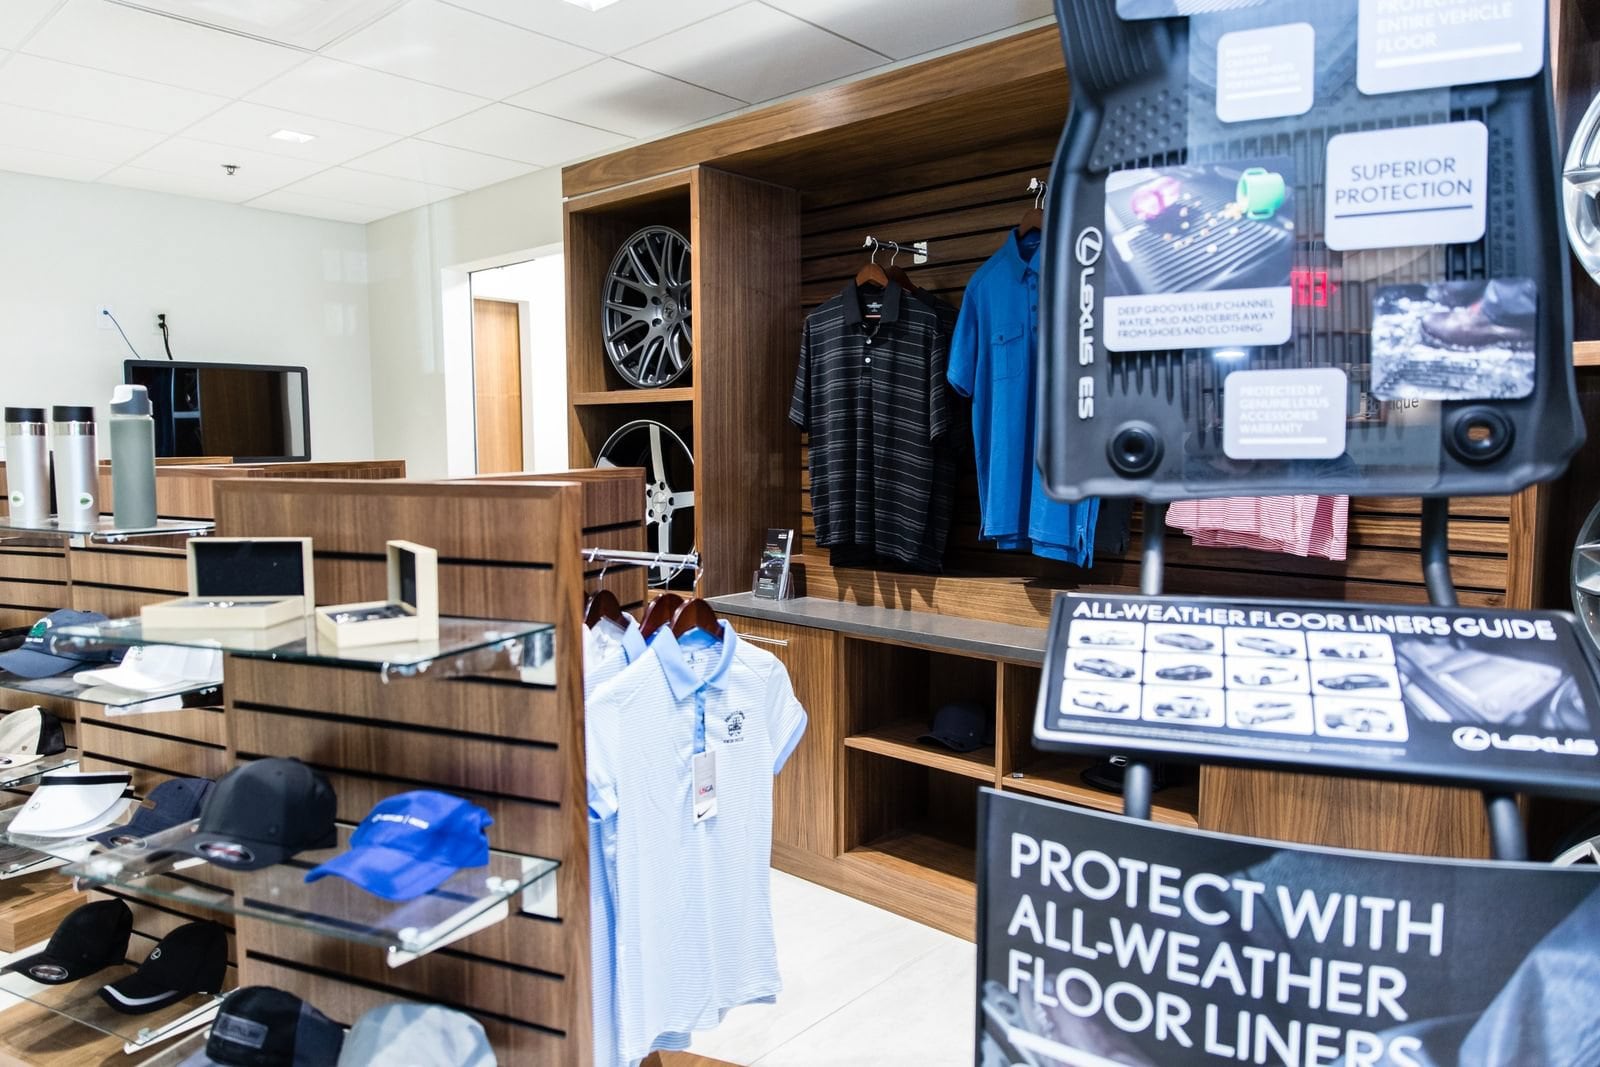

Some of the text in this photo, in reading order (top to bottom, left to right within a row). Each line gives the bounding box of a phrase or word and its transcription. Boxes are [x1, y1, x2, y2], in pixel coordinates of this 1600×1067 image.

[1376, 0, 1467, 15] PROTEC
[1376, 1, 1513, 34] ENTIRE VEHICLE
[1375, 31, 1440, 54] FLOOR
[1351, 157, 1457, 182] SUPERIOR
[1335, 178, 1473, 205] PROTECTION
[1079, 267, 1095, 366] LEXUS
[1118, 299, 1274, 316] DEEP GROOVES HELP CHANNEL
[1155, 315, 1180, 324] MUD
[1181, 314, 1204, 324] AND
[1205, 313, 1241, 323] DEBRIS
[1242, 311, 1276, 320] AWAY
[1117, 323, 1263, 338] FROM SHOES AND CLOTHING
[1078, 376, 1094, 420] ES
[1239, 384, 1322, 397] PROTECTED BY
[1239, 396, 1330, 409] GENUINE LEXUS
[1239, 410, 1319, 421] ACCESSORIES
[1239, 423, 1304, 433] WARRANTY
[1072, 601, 1557, 641] ALL-WEATHER FLOOR LINERS GUIDE
[1491, 732, 1599, 757] LEXUS
[1011, 832, 1445, 957] PROTECT WITH
[1007, 894, 1409, 1022] ALL-WEATHER
[1008, 948, 1423, 1067] FLOOR LINERS
